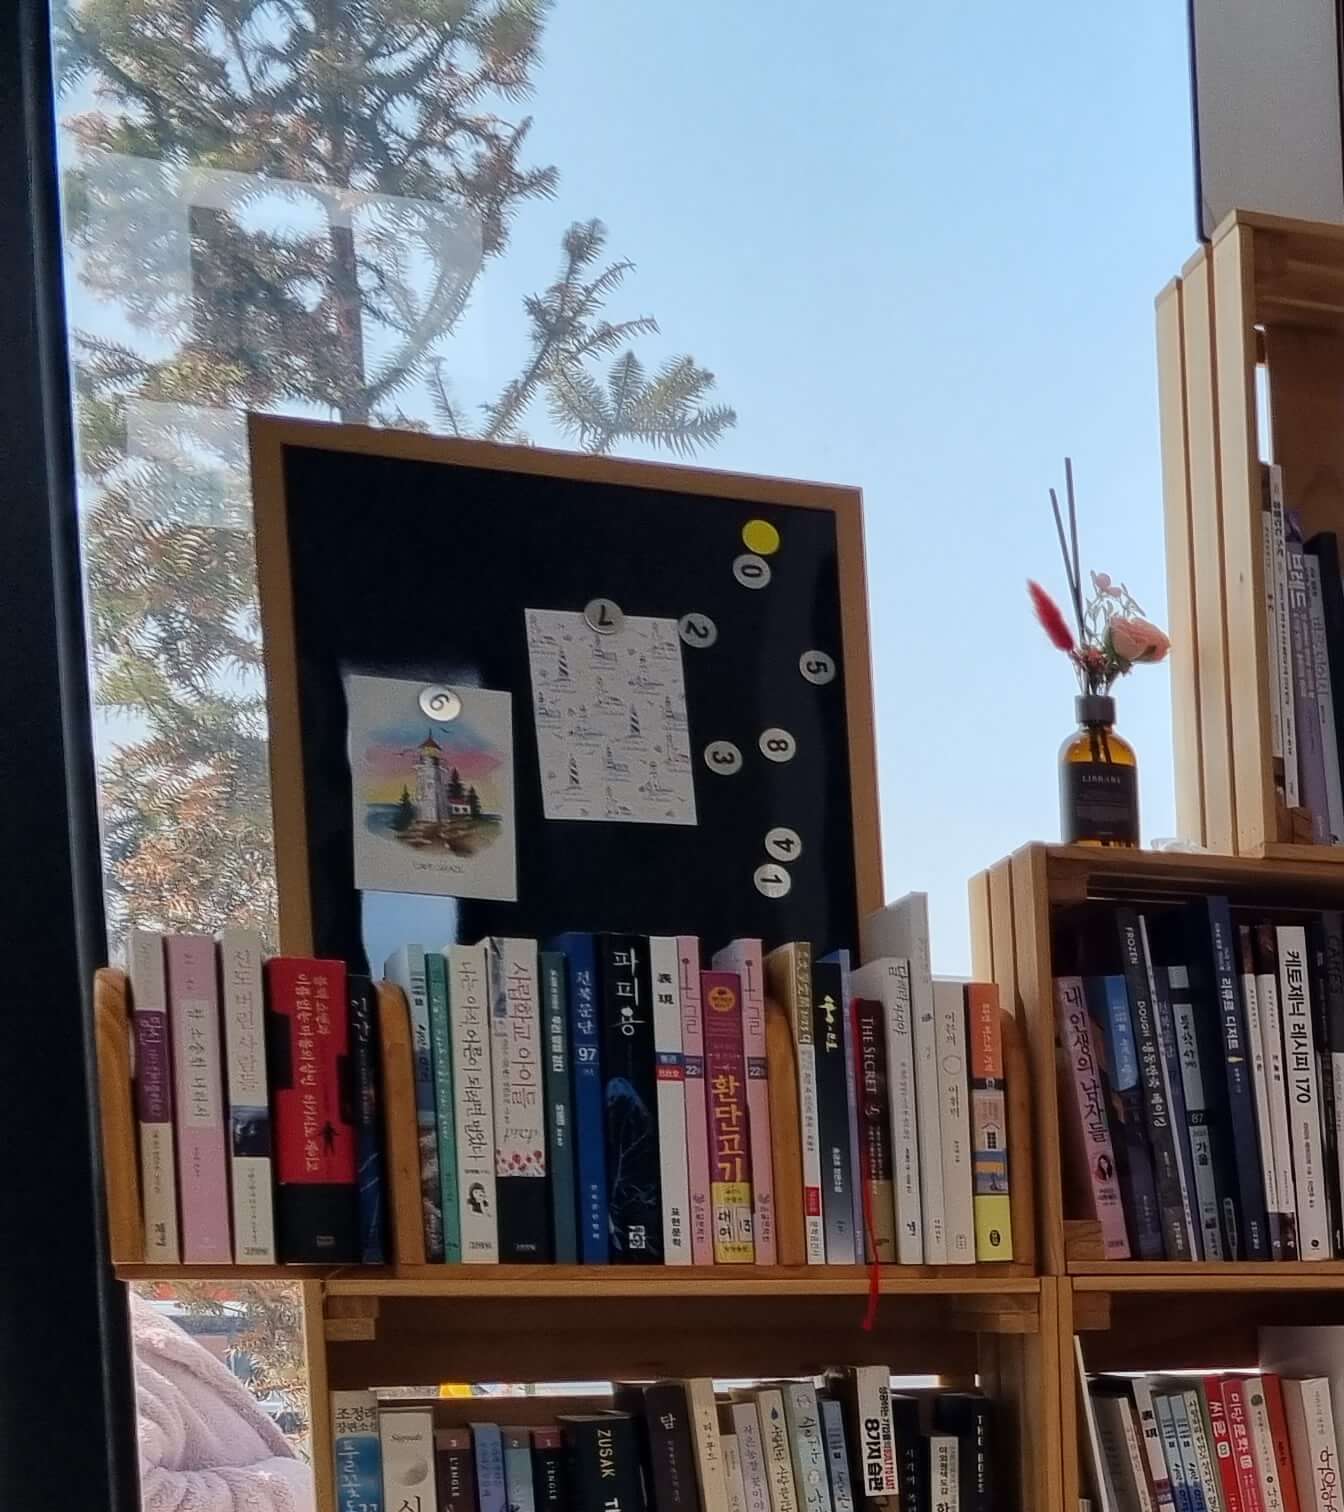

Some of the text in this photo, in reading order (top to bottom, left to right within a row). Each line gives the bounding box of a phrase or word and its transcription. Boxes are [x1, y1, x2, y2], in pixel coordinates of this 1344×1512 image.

[296, 974, 312, 998] 이름
[296, 999, 313, 1024] 없는
[611, 947, 647, 1037] 파피용
[1220, 976, 1241, 1051] 리큐르 디저트
[298, 1025, 315, 1061] 마을의
[461, 1028, 484, 1073] 어른이
[507, 961, 537, 1110] 사립학교 아이들
[577, 1047, 598, 1062] 97
[861, 1017, 879, 1096] THE SECRET
[1125, 927, 1138, 965] FROZEN
[1136, 1001, 1150, 1039] DOUGH
[1151, 1092, 1167, 1128] 베이킹
[1285, 949, 1312, 1104] 케토제닉 레시피 170
[464, 1075, 486, 1117] 되려면
[711, 1074, 746, 1182] 환단고기
[596, 1429, 616, 1479] ZUSAK
[864, 1417, 886, 1492] 8가지 습관
